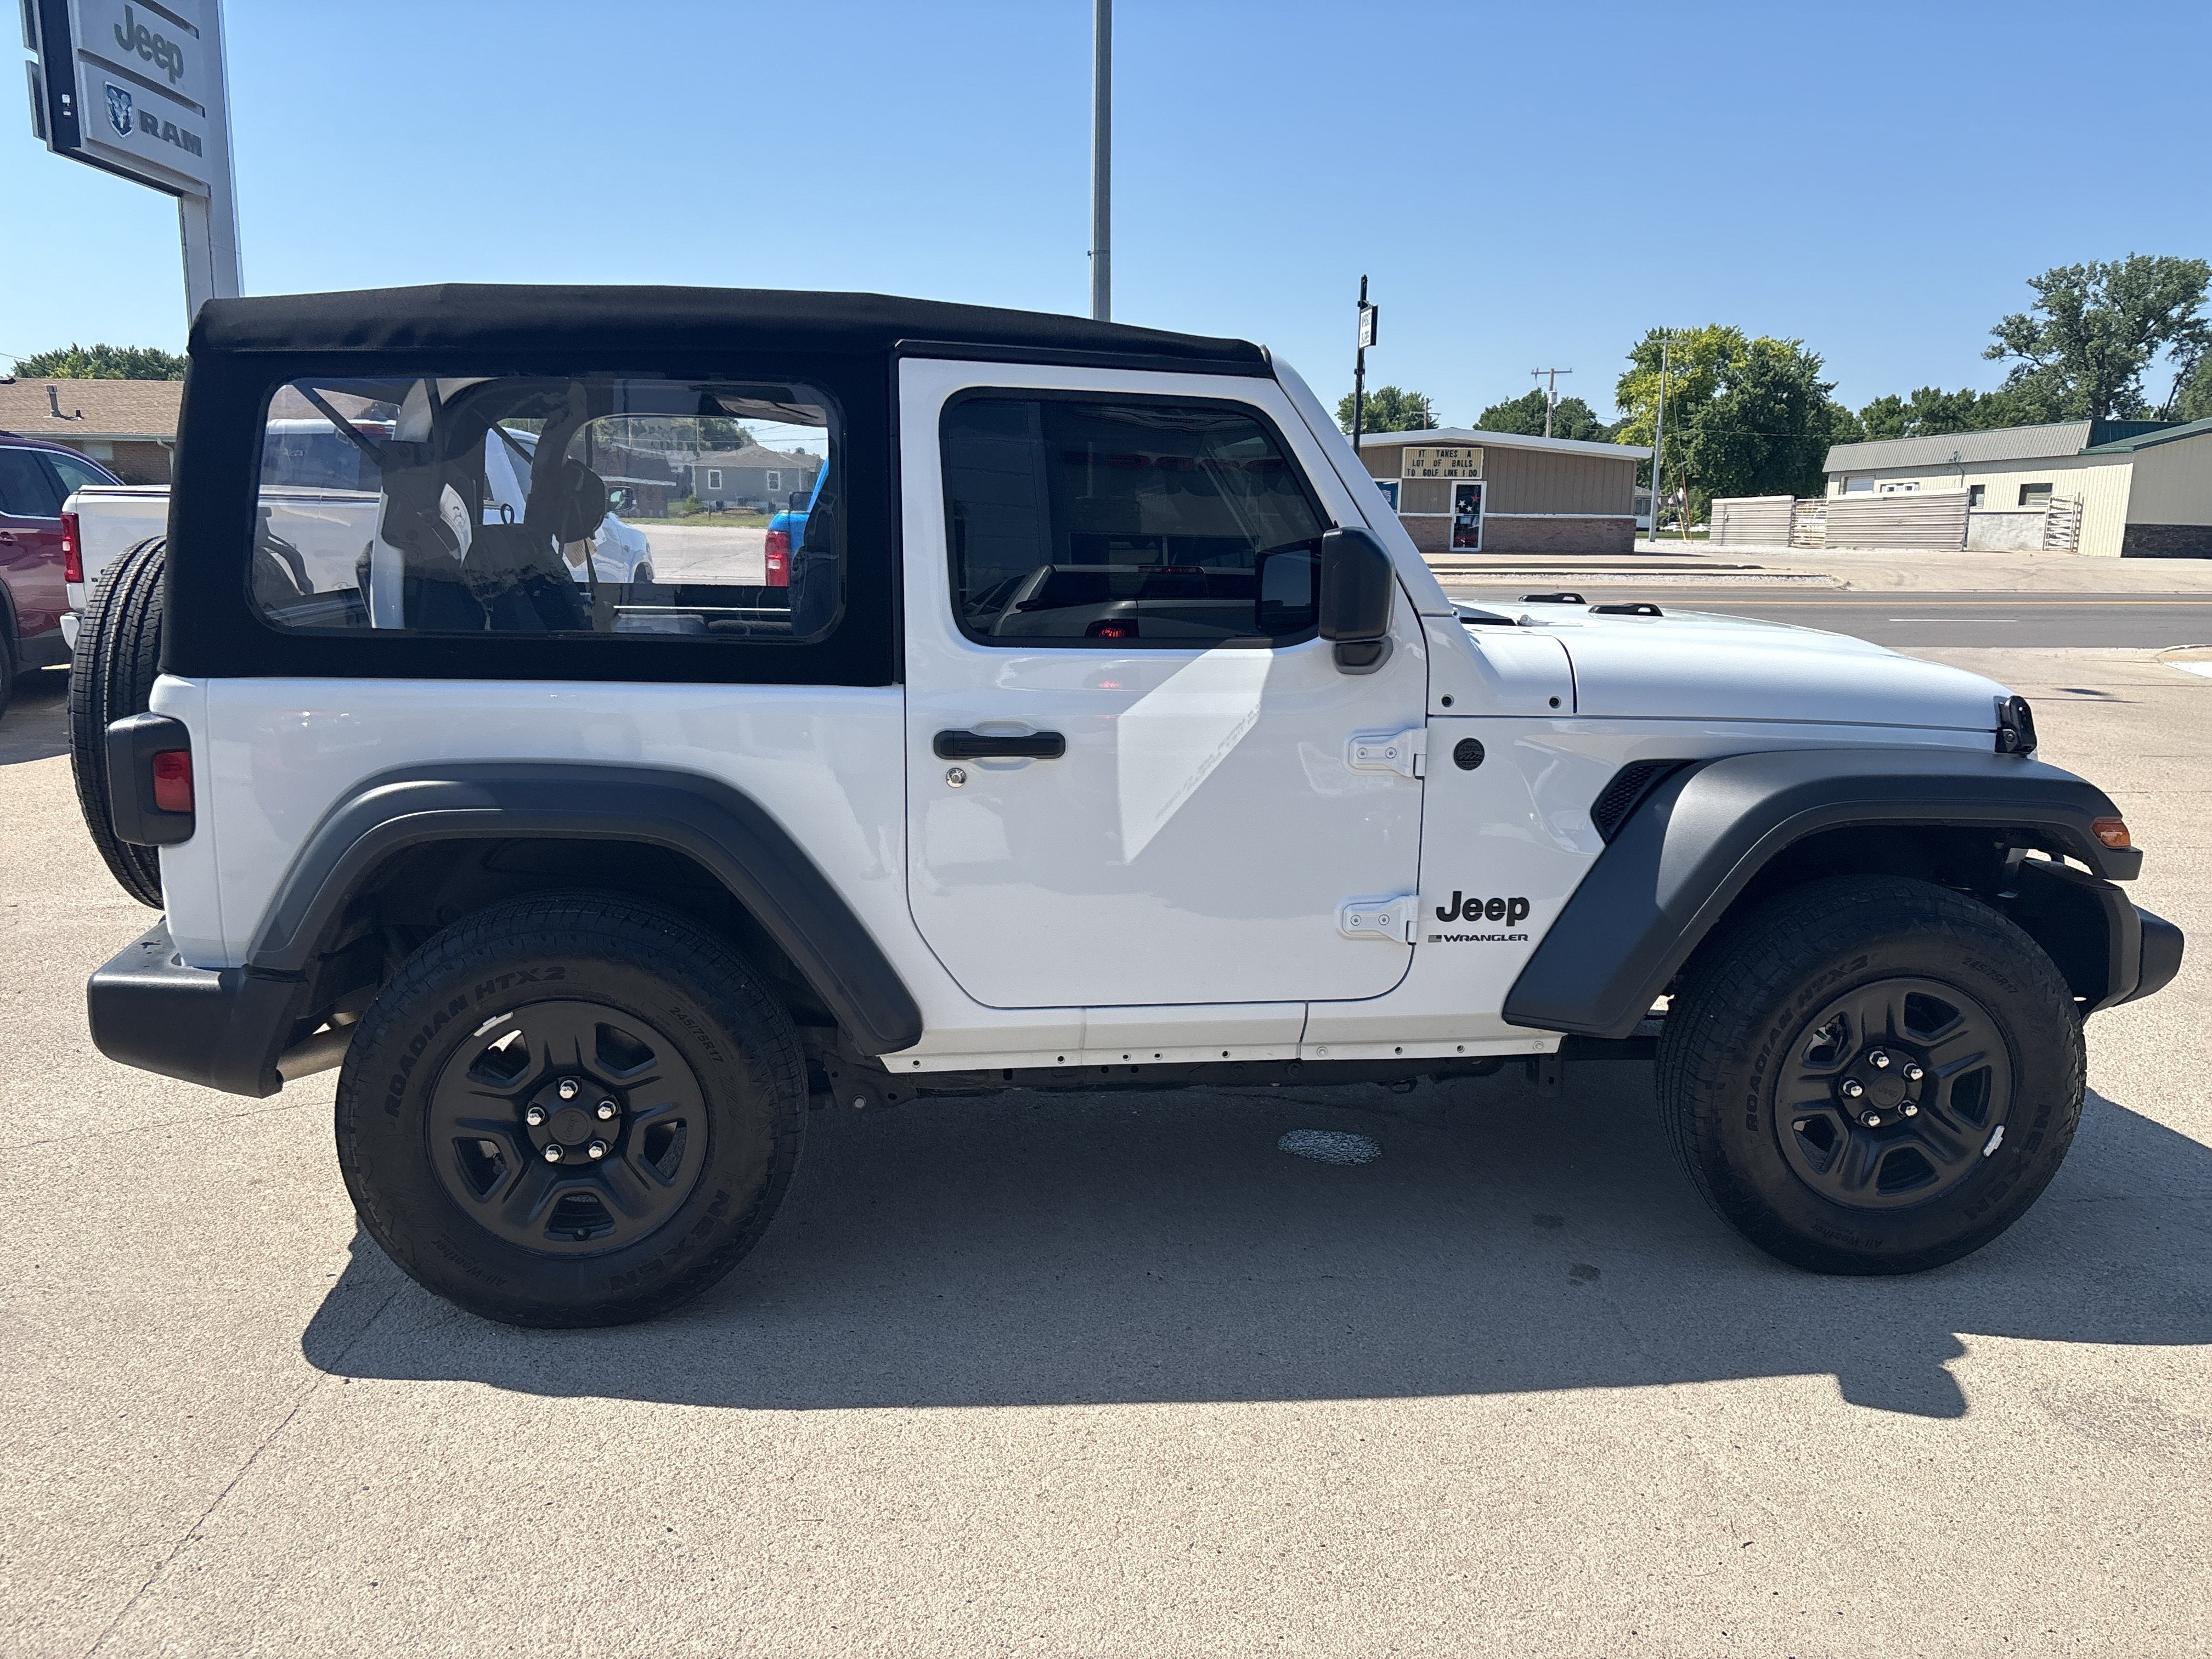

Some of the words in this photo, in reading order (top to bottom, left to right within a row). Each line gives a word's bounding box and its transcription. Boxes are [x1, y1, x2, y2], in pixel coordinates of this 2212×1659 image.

[114, 4, 184, 84] Jeep
[138, 109, 202, 157] RAM
[1407, 469, 1415, 477] TO
[1423, 469, 1439, 477] GOLF
[1436, 890, 1530, 927] Jeep
[385, 994, 468, 1118] ROADIAN
[475, 966, 566, 1001] HTX2
[669, 1007, 724, 1063] 245/75R17
[1746, 1008, 1793, 1131] ROADIAN
[431, 1240, 508, 1286] All-Weather
[610, 1189, 731, 1290] NEXEN
